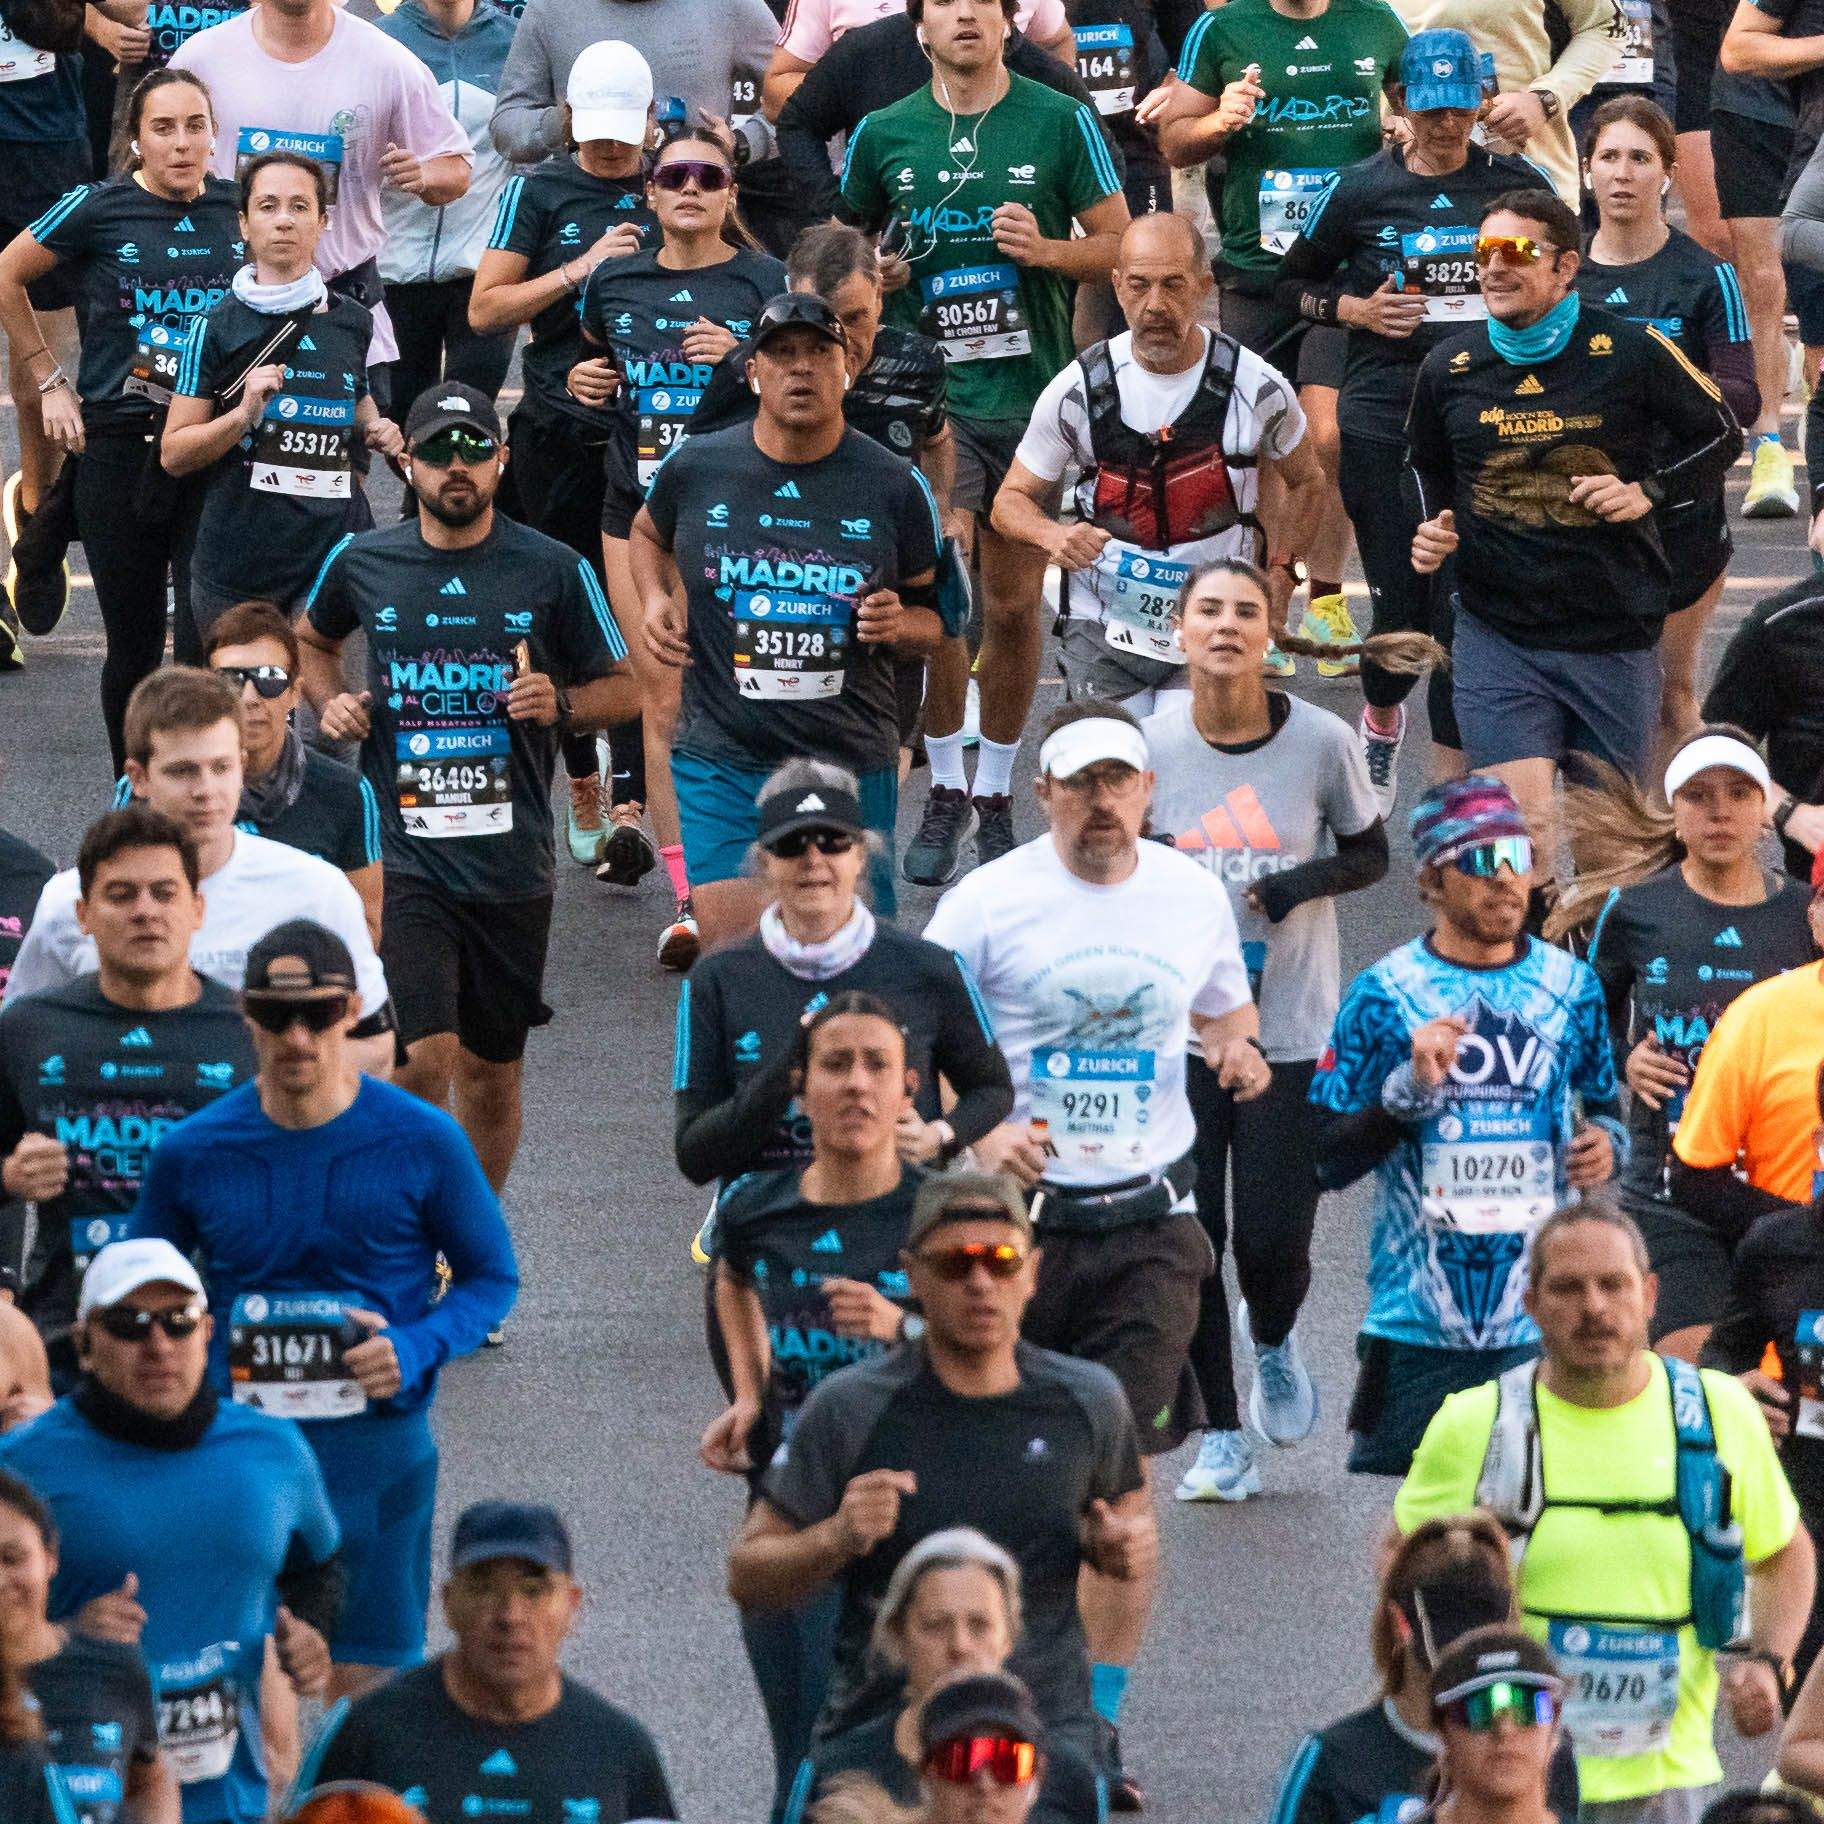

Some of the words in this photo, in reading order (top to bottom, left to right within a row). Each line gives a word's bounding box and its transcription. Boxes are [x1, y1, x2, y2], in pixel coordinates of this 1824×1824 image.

[1301, 65, 1332, 74] ZURICH
[1257, 95, 1368, 125] MADRID
[274, 138, 326, 152] ZURICH
[181, 248, 211, 256] ZURICH
[949, 270, 1001, 287] ZURICH
[937, 298, 998, 327] 30567
[296, 370, 326, 378] ZURICH
[303, 403, 346, 418] ZURICH
[1499, 418, 1563, 436] MADRID
[280, 431, 338, 456] 35312
[776, 518, 811, 529] ZURICH
[720, 558, 864, 594] MADRID
[776, 601, 832, 616] ZURICH
[441, 615, 477, 626] ZURICH
[755, 631, 825, 658] 35128
[772, 657, 804, 670] HENRY
[421, 690, 497, 716] CIELO
[436, 734, 491, 750] ZURICH
[419, 766, 488, 794] 36405
[435, 793, 474, 805] MANUEL
[1078, 1057, 1138, 1074] ZURICH
[1063, 1092, 1120, 1121] 9291
[1470, 1116, 1529, 1136] ZURICH
[1451, 1157, 1526, 1181] 10270
[253, 1336, 332, 1365] 31671
[1579, 1675, 1646, 1705] 9670
